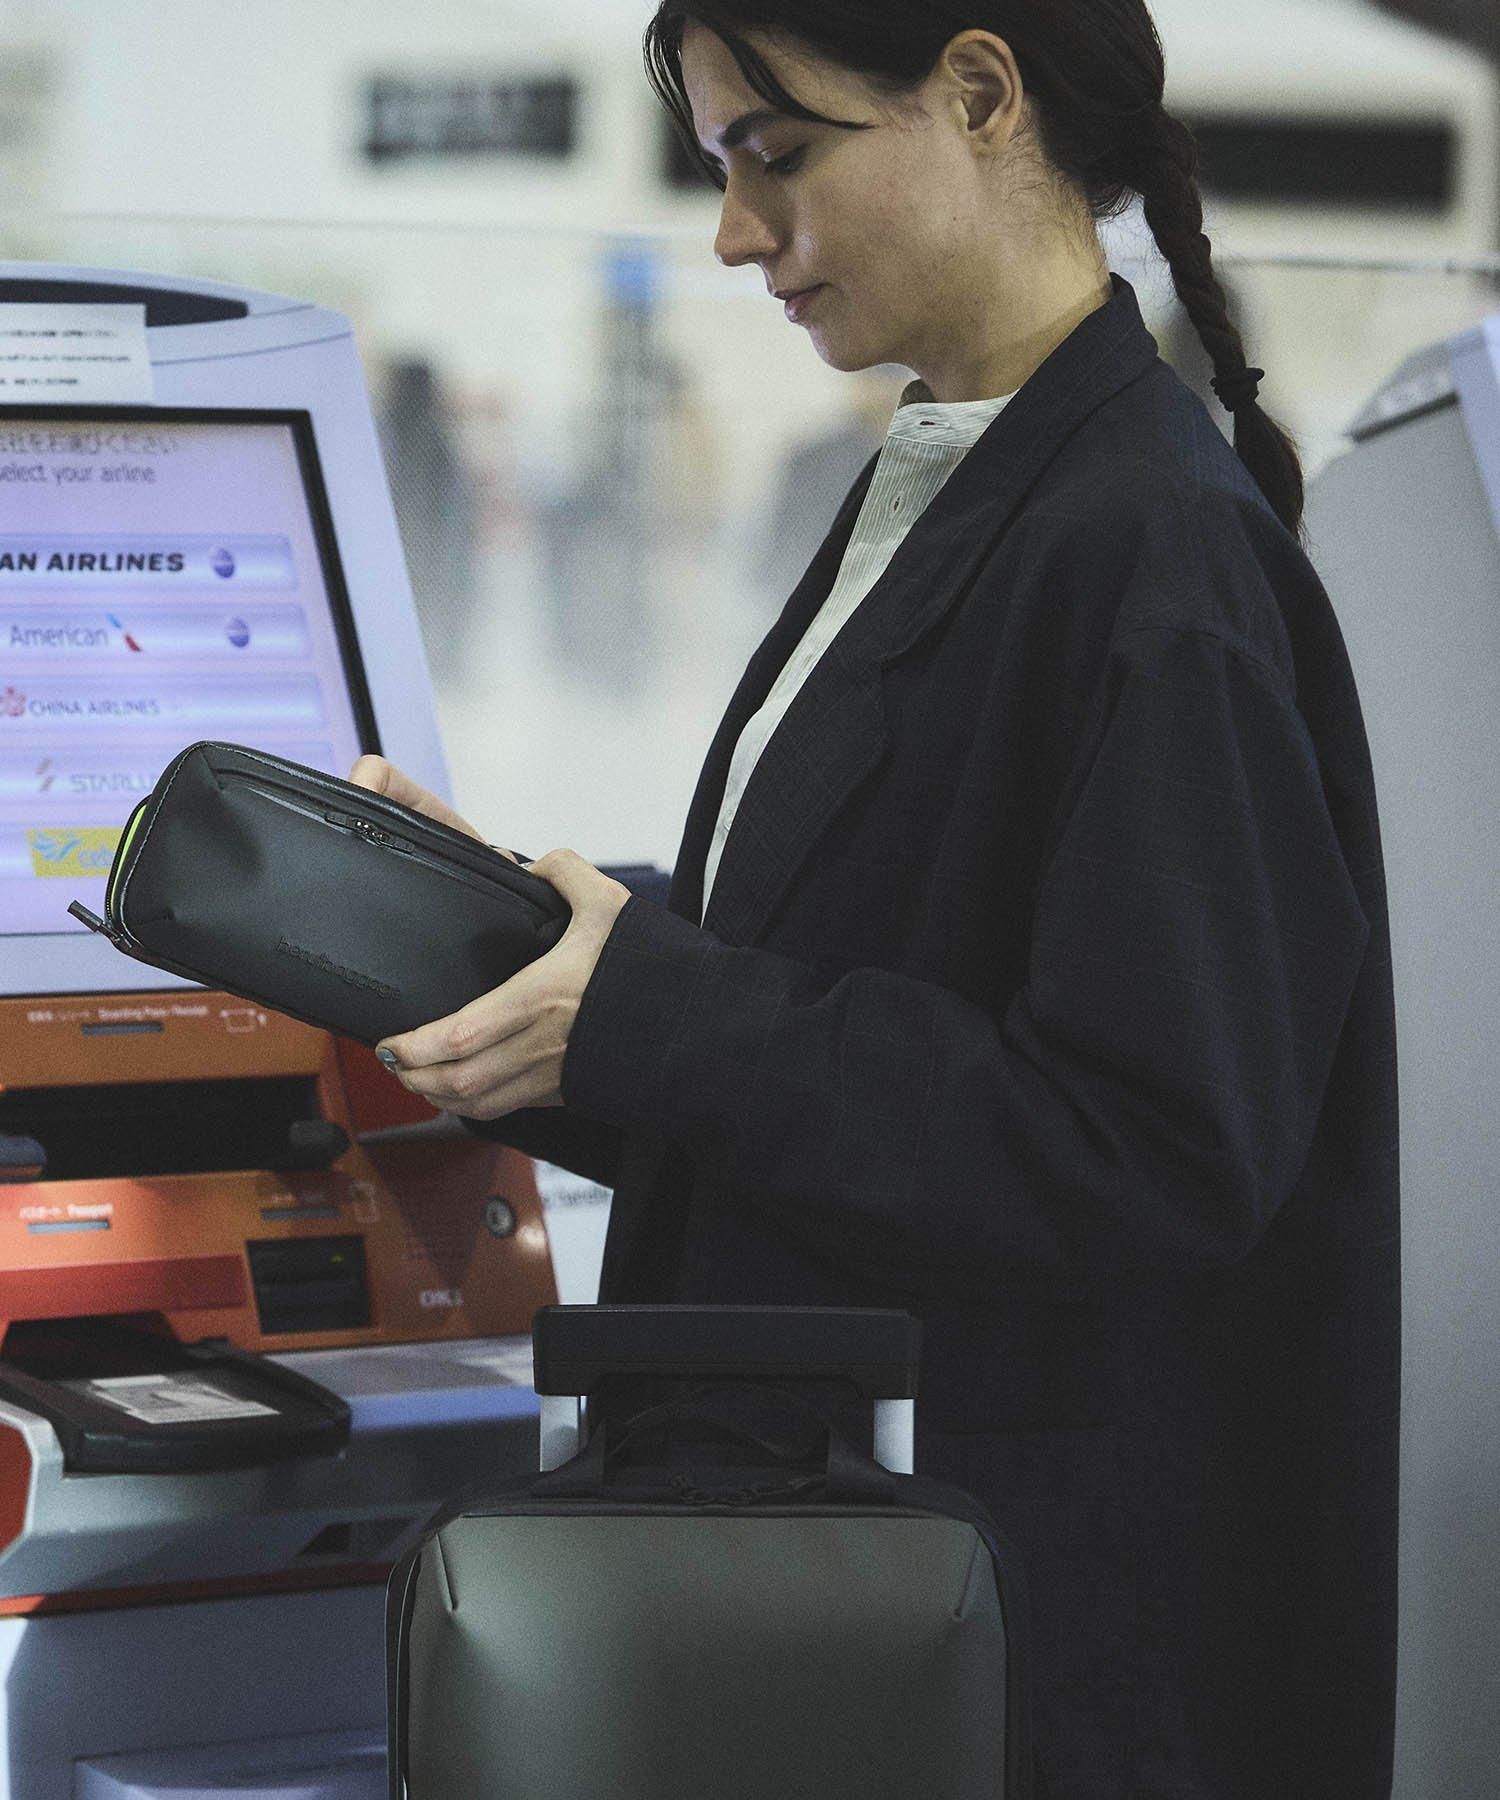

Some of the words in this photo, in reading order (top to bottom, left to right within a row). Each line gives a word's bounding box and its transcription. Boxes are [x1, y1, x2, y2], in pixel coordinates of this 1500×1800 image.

[52, 466, 93, 486] your
[101, 464, 156, 483] airline
[0, 553, 37, 571] AN
[48, 553, 184, 572] AIRLINES
[10, 625, 109, 647] American
[29, 700, 82, 716] CHINA
[88, 700, 160, 715] AIRLINES
